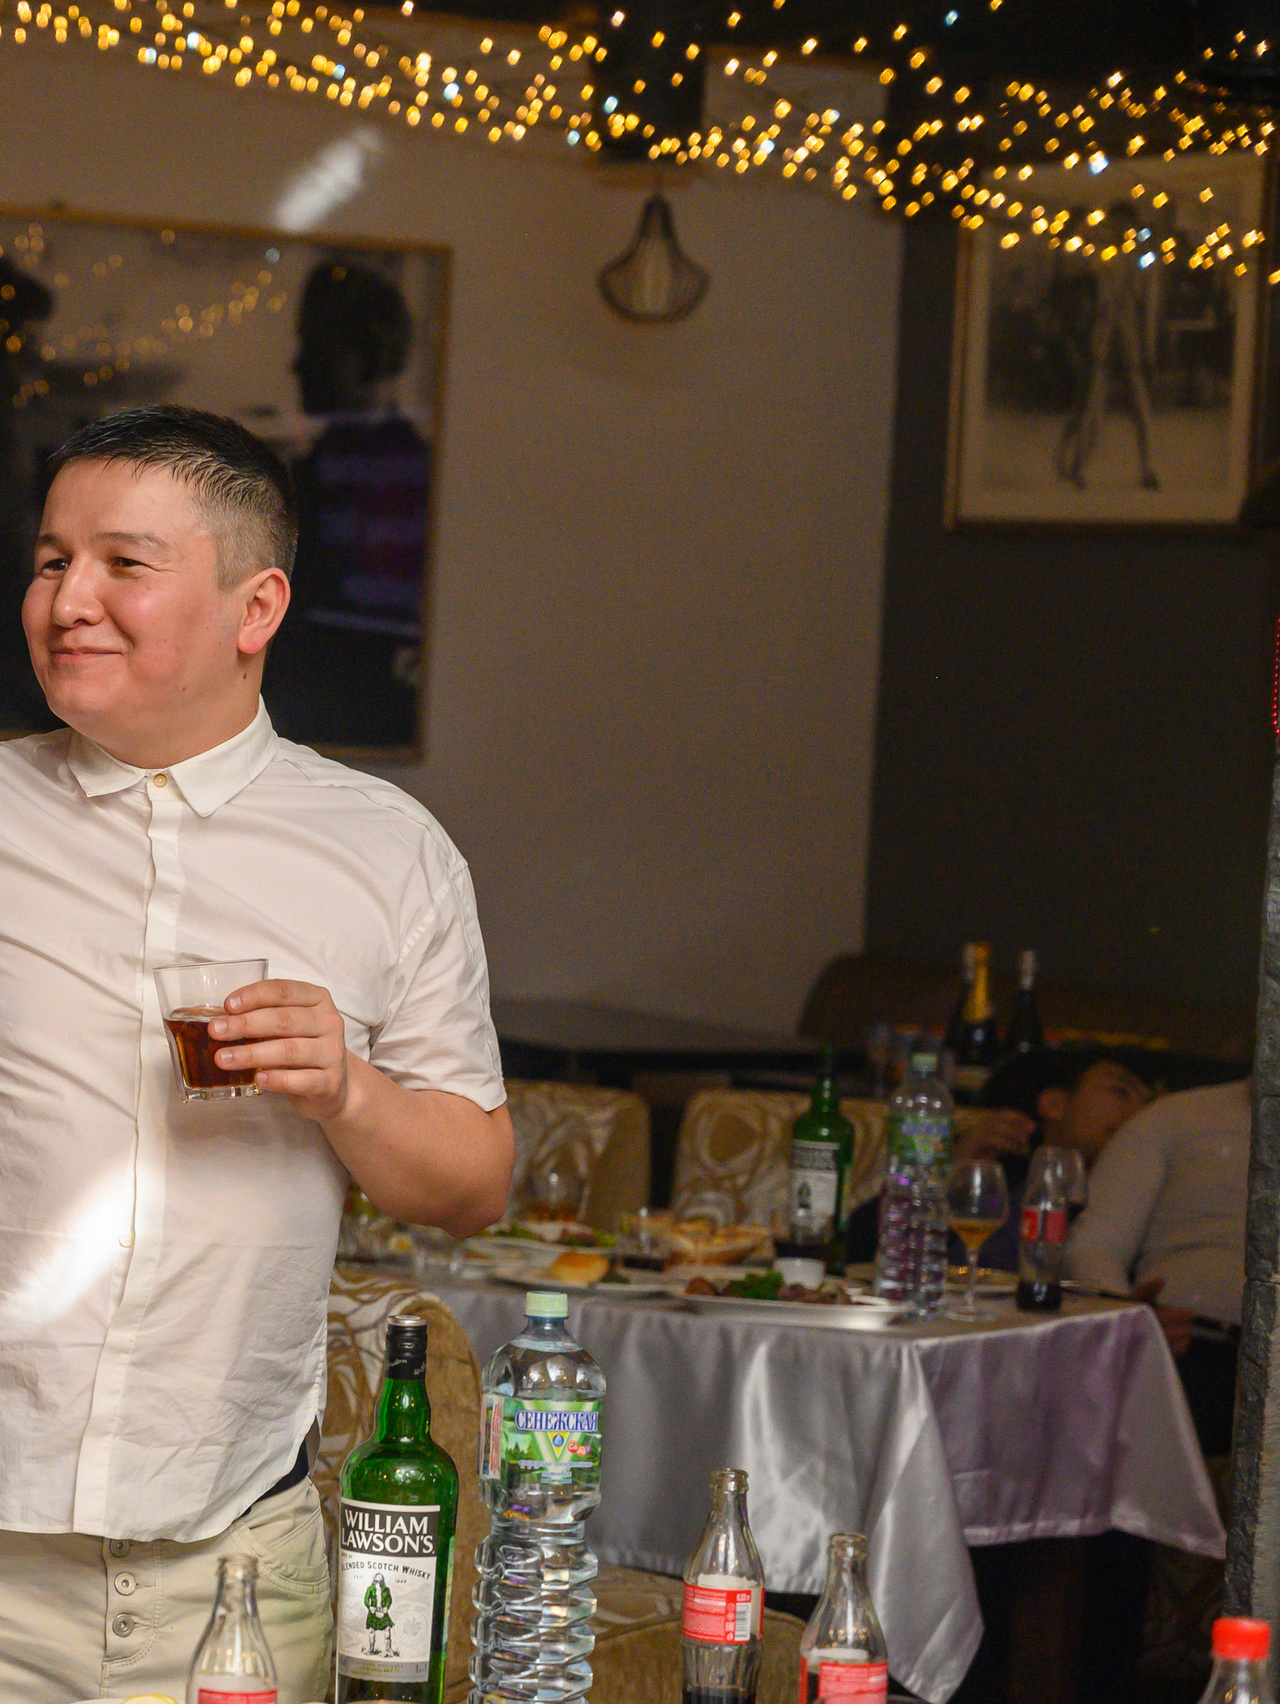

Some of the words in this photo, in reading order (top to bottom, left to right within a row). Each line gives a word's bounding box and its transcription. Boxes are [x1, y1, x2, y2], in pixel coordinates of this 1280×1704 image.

[515, 1410, 599, 1432] СЕНЕЖСКАЯ
[344, 1508, 429, 1535] WILLIAM
[341, 1527, 434, 1554] LAWSON'S
[402, 1565, 431, 1581] WHISKY
